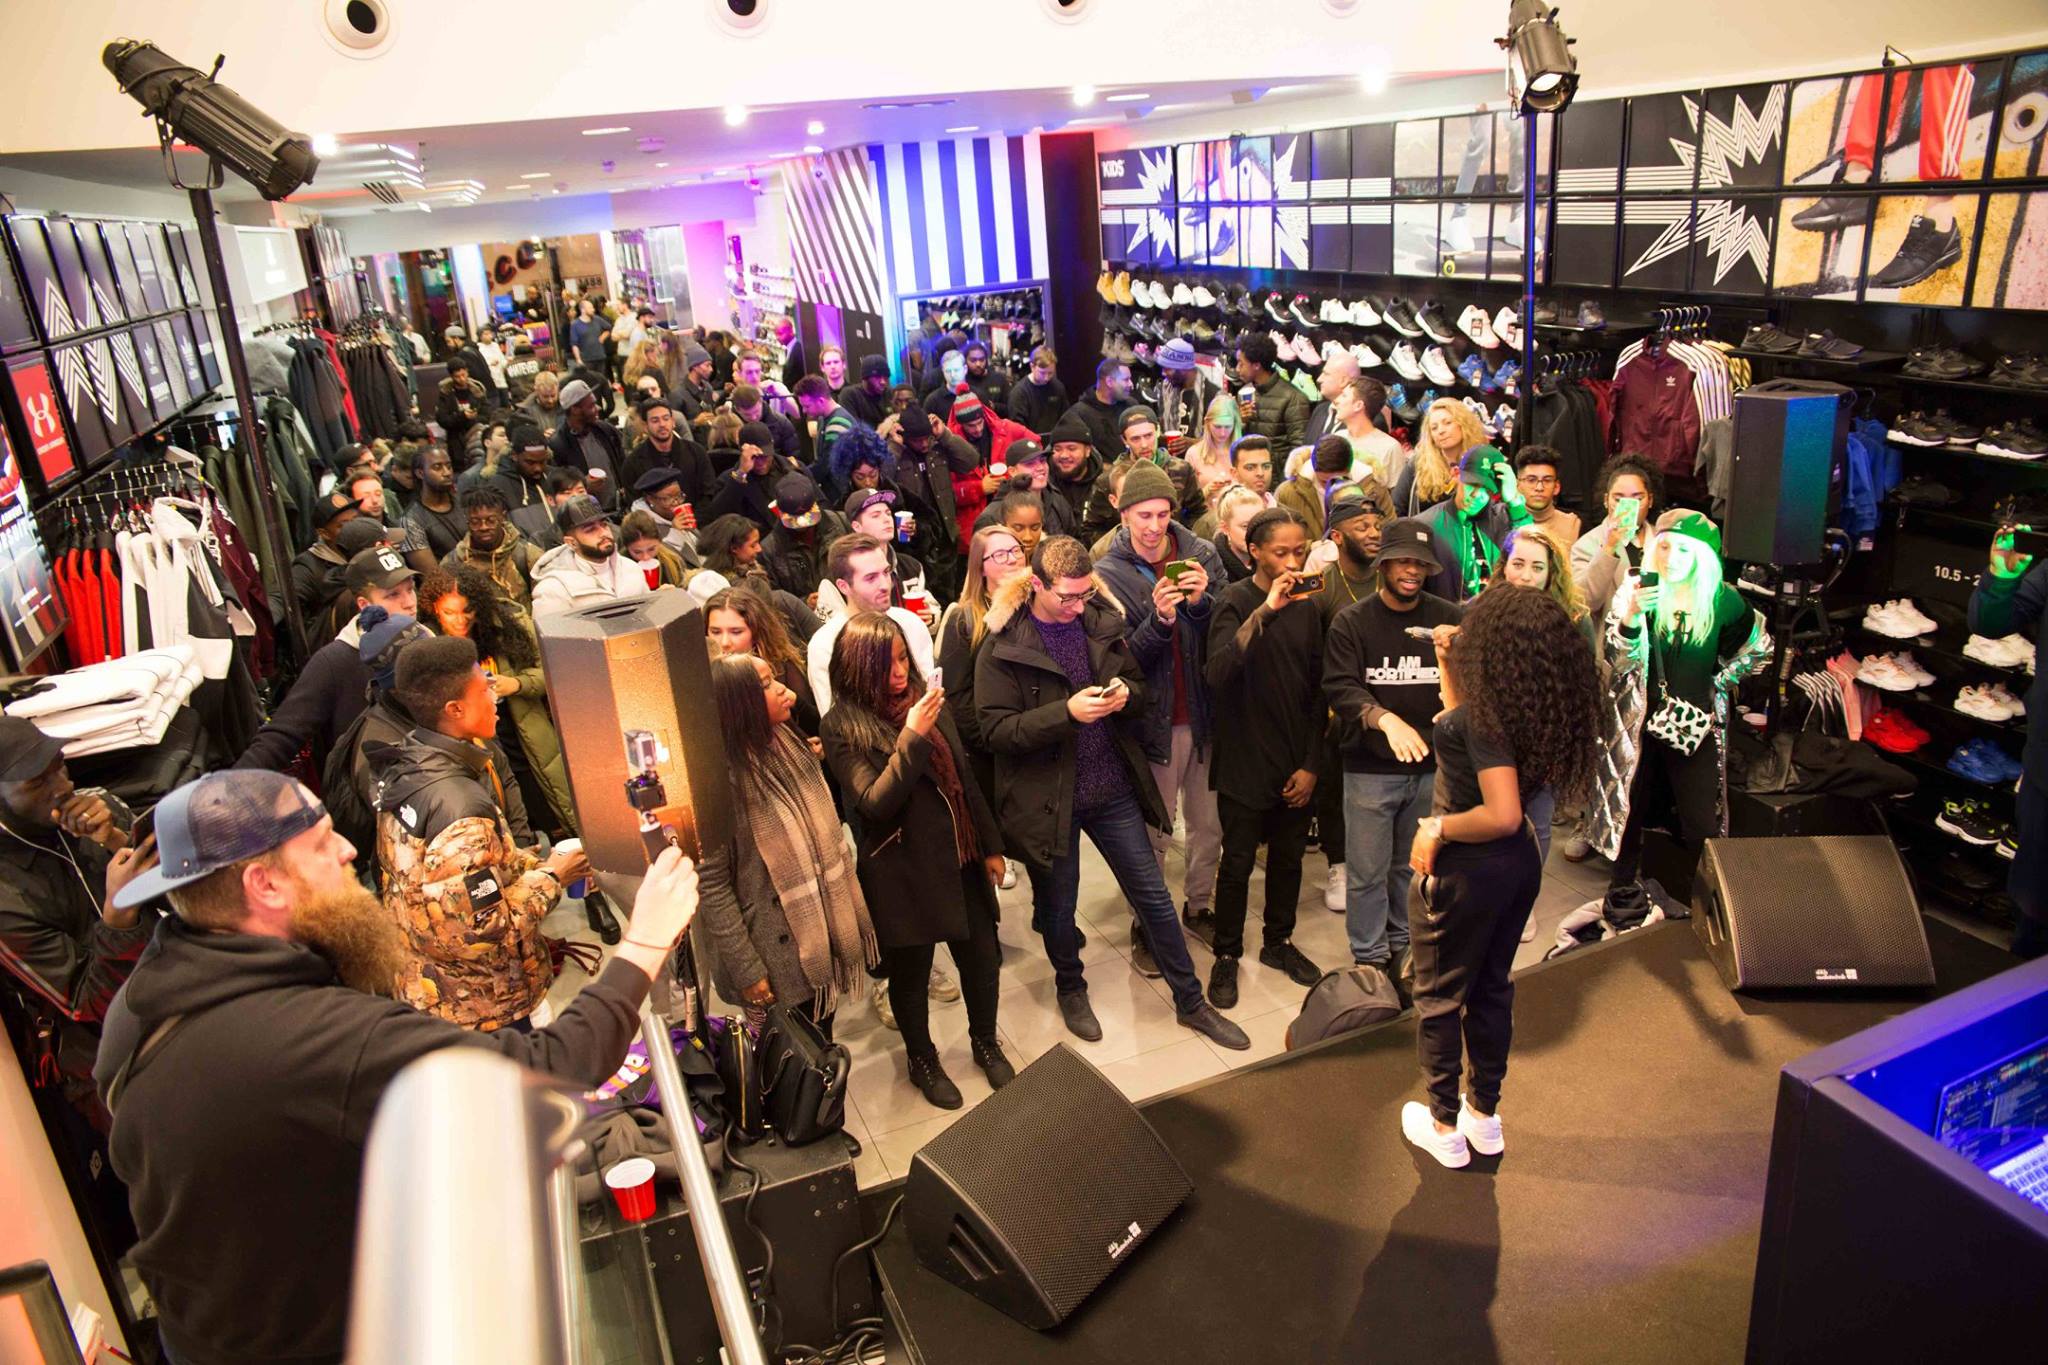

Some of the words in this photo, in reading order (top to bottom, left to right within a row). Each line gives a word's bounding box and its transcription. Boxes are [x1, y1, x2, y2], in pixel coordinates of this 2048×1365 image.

[1934, 565, 1962, 581] 10.5
[1383, 656, 1389, 669] I
[1397, 655, 1421, 670] AM
